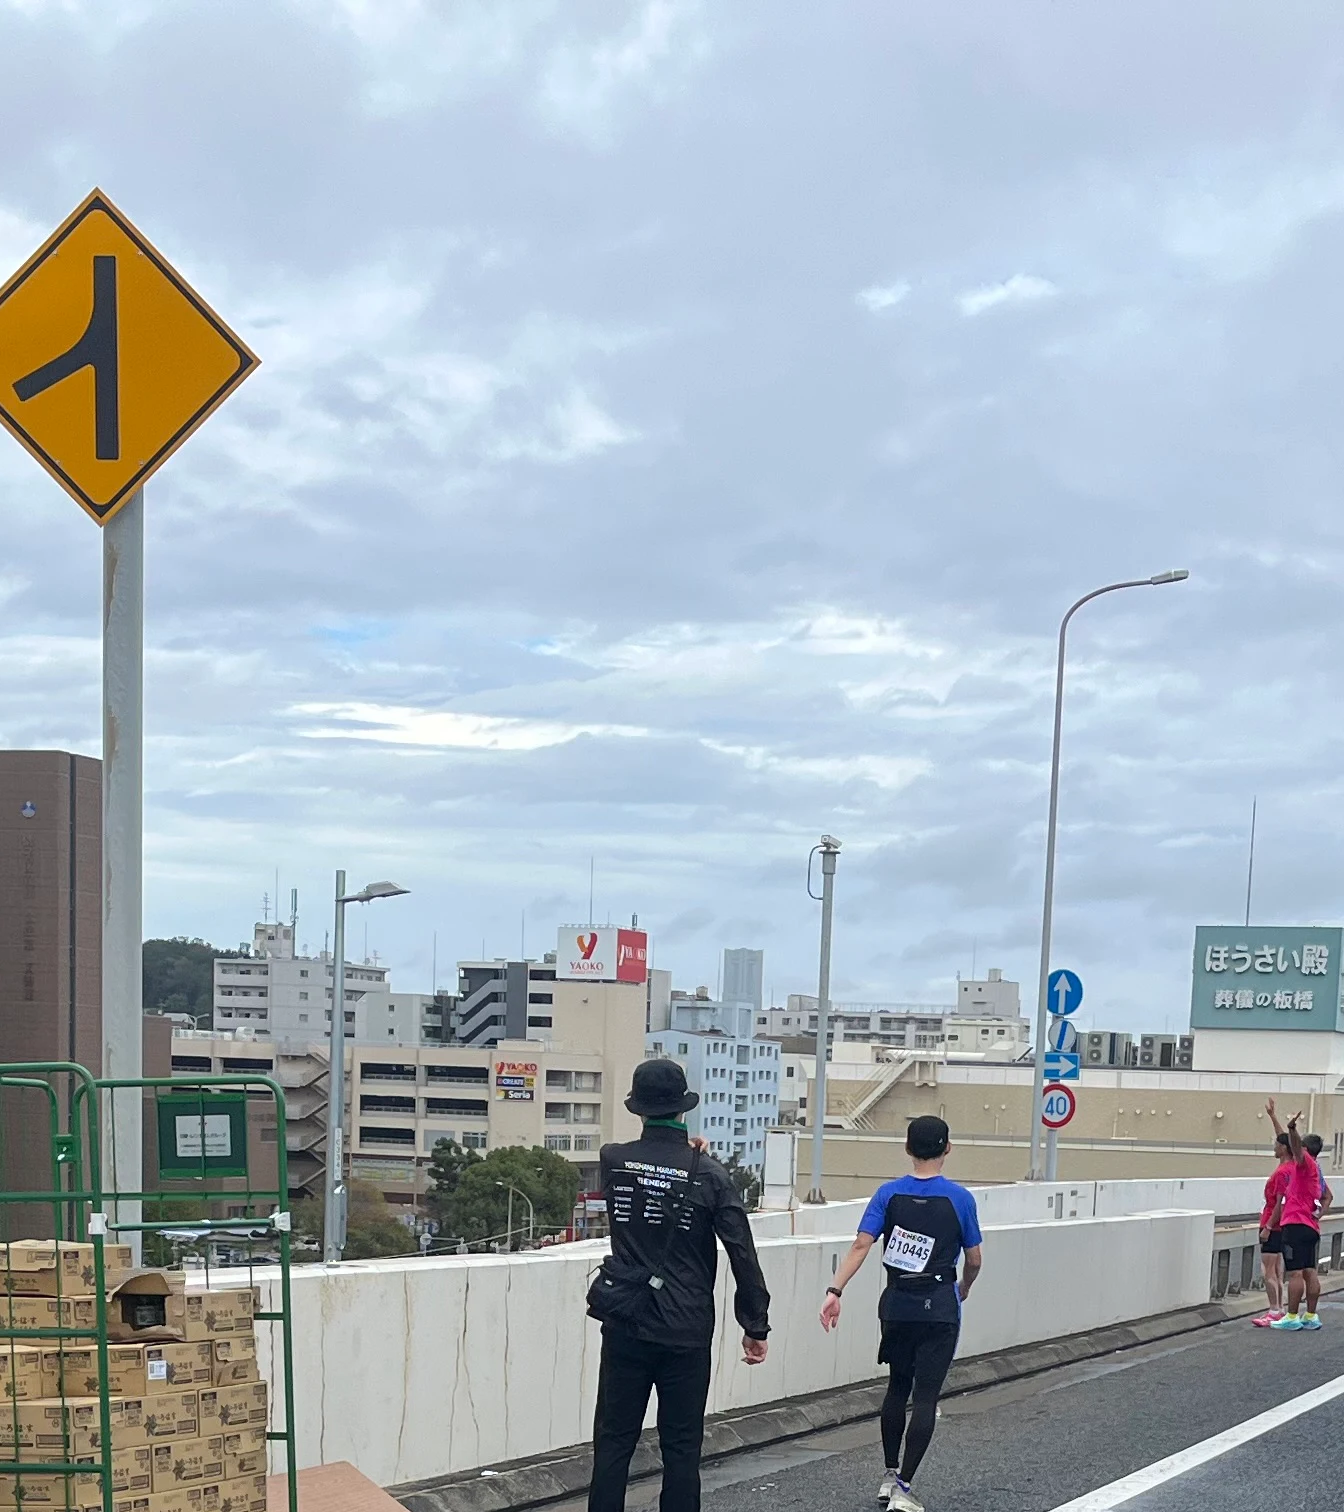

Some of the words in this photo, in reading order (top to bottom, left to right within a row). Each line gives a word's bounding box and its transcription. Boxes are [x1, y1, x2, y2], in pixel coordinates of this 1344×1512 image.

[570, 961, 604, 971] YAOKO
[1205, 944, 1329, 976] ほうさい殿
[1214, 989, 1314, 1011] 葬儀の板橋
[508, 1090, 531, 1099] Seria
[1044, 1096, 1067, 1116] 40
[643, 1178, 672, 1189] ENEOS
[888, 1236, 931, 1261] D10445
